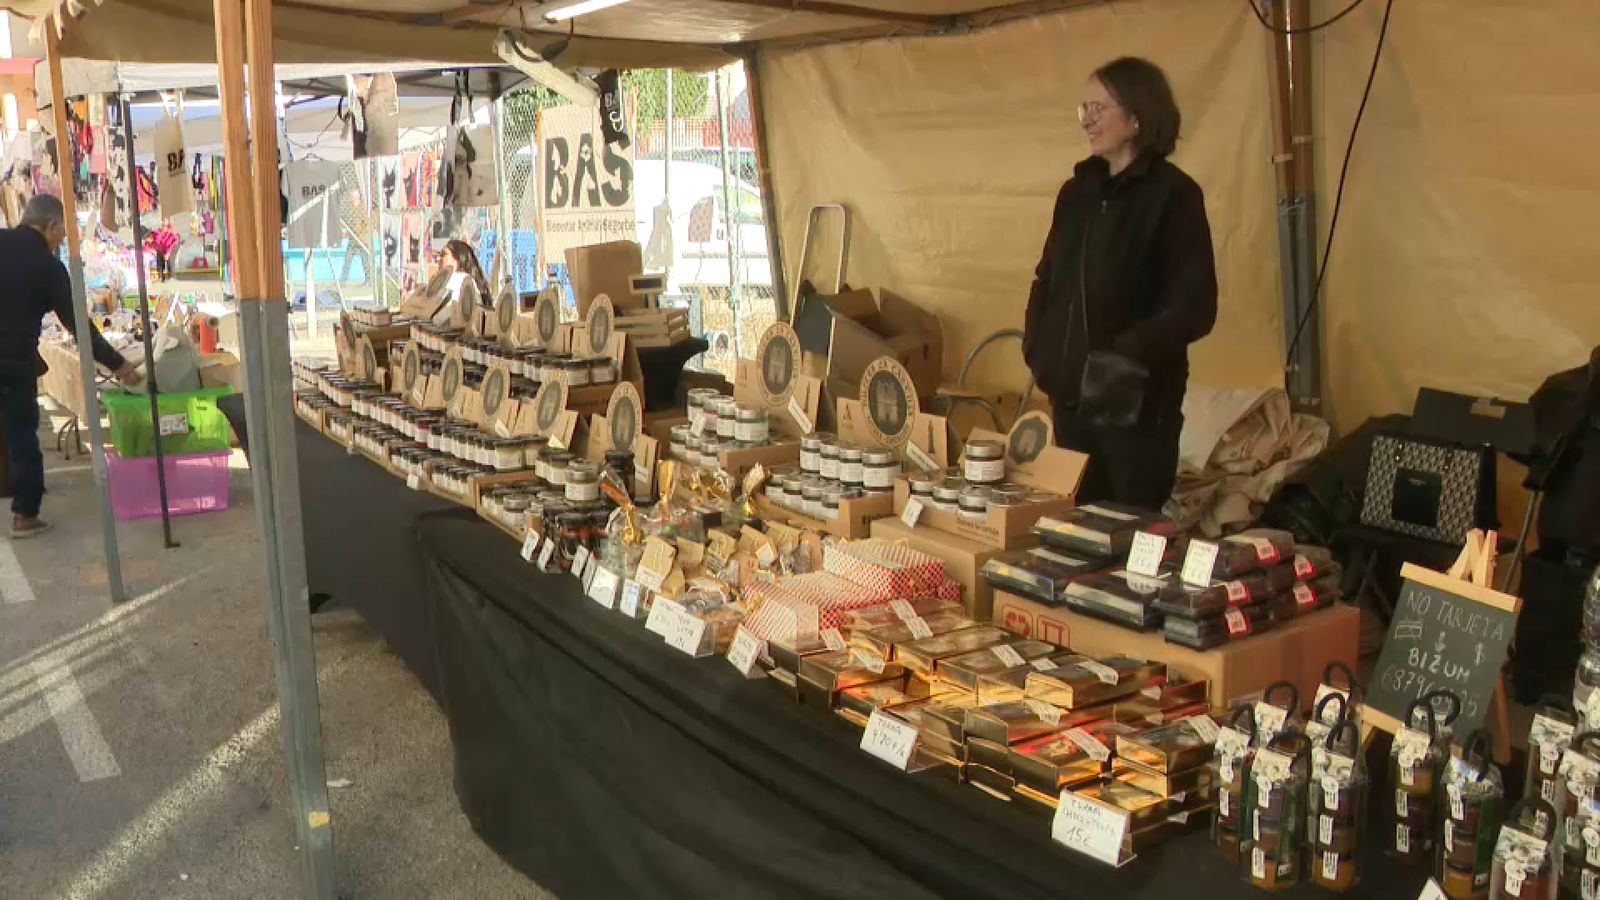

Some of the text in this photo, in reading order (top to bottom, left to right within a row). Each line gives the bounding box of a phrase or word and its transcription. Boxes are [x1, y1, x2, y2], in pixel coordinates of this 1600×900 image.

[545, 133, 634, 208] BAS
[1408, 590, 1504, 640] NO TARJETA
[1408, 647, 1471, 681] BIZUM
